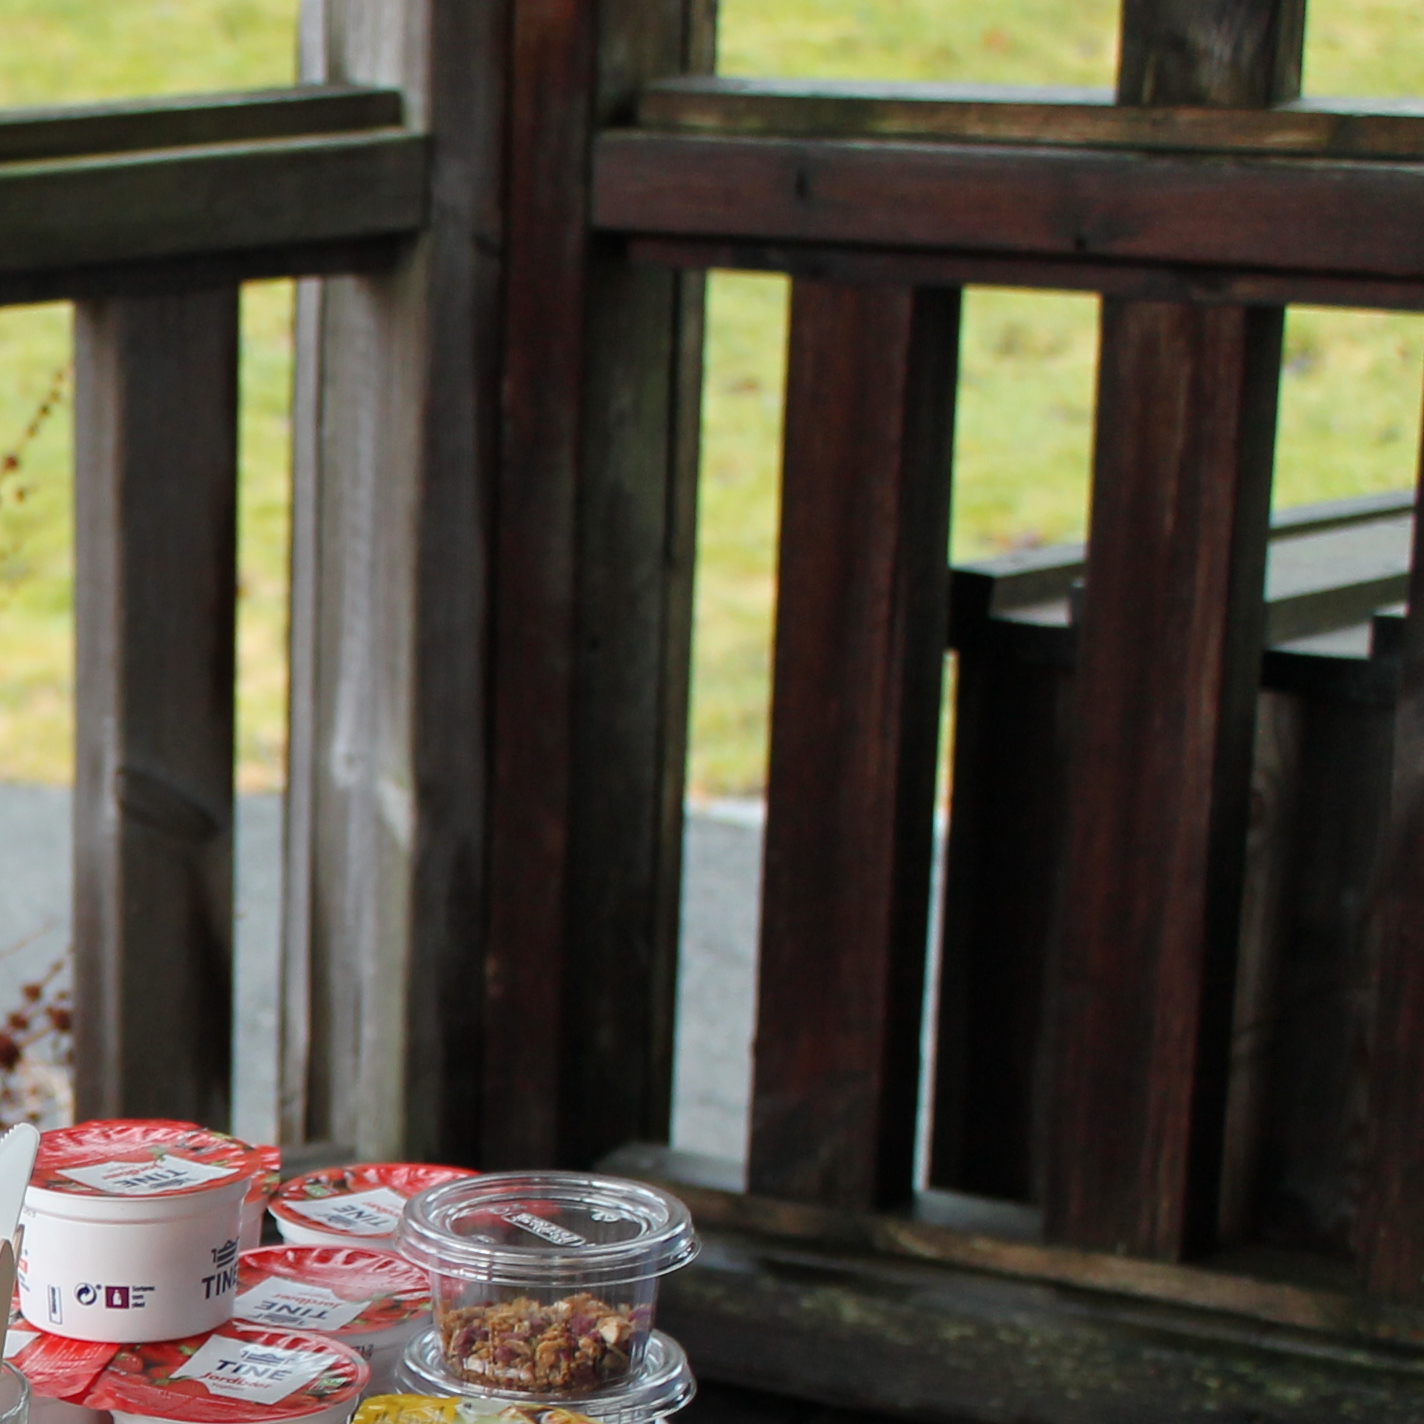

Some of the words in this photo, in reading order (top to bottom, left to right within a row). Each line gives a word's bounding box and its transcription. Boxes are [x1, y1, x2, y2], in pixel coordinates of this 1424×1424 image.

[113, 1169, 188, 1189] TINE
[336, 1204, 390, 1228] TINE
[255, 1300, 329, 1320] TINE
[216, 1358, 294, 1382] TINE
